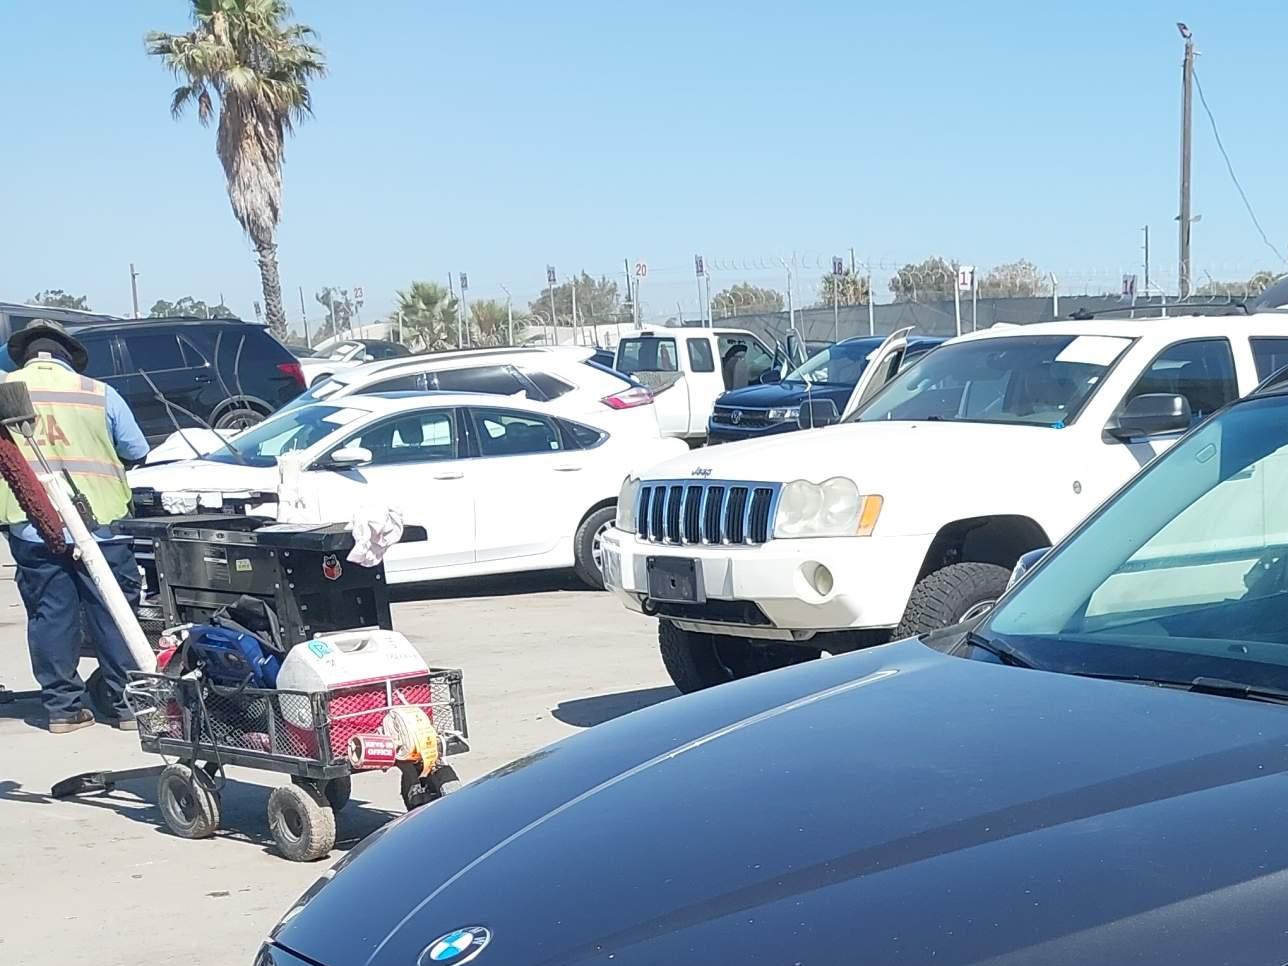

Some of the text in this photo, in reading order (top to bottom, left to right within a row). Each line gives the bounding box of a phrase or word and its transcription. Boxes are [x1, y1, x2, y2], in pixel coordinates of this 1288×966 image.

[636, 264, 647, 276] 20
[832, 262, 843, 276] 18
[353, 287, 364, 299] 23
[691, 466, 712, 479] Jeep
[367, 748, 393, 756] OFFICE
